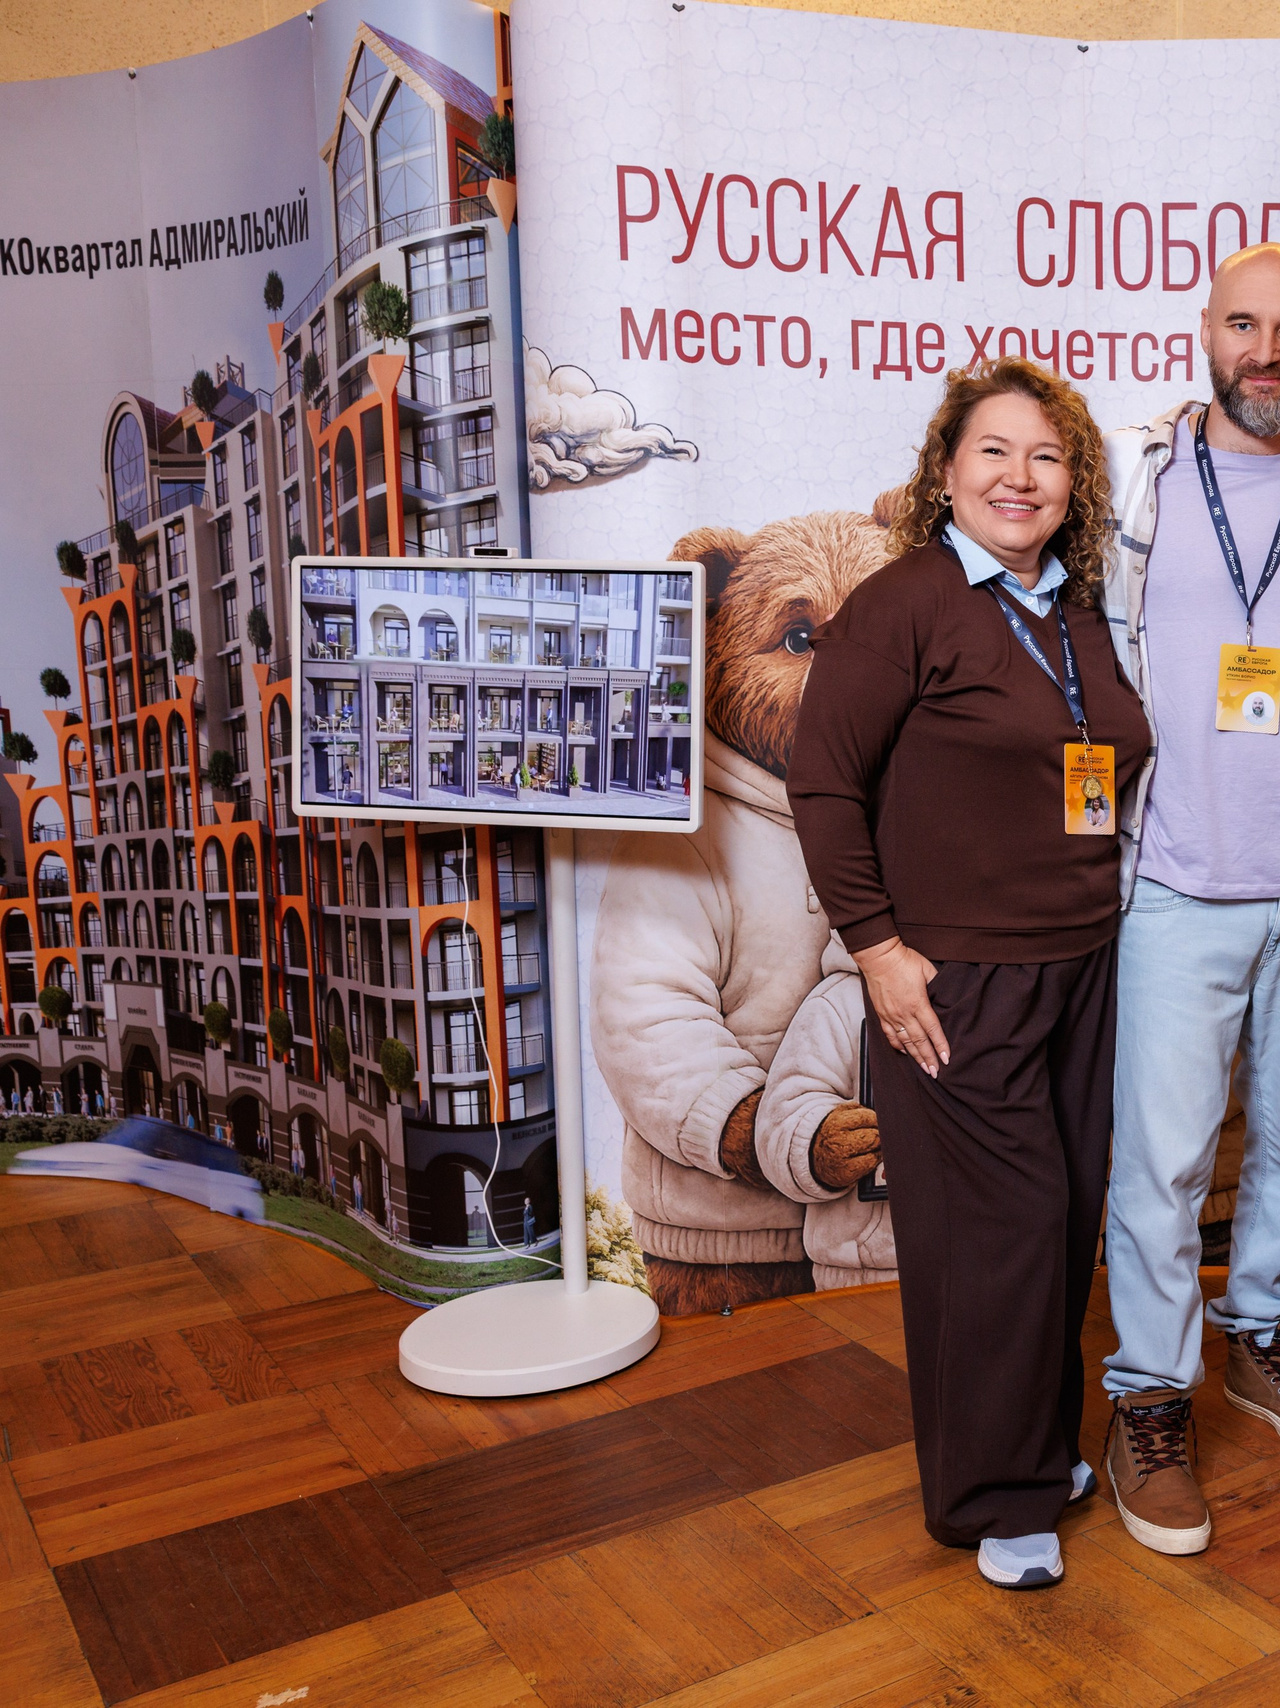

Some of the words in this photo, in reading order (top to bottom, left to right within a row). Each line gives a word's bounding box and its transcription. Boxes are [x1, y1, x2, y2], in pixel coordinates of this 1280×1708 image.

[149, 186, 310, 272] АДМИРАЛЬСКИЙ
[616, 164, 965, 282] РУССКАЯ
[619, 306, 829, 379] место,
[850, 319, 946, 382] где
[1214, 507, 1222, 517] RE
[1011, 619, 1021, 630] RE
[1227, 667, 1277, 675] АМБАССАДОР
